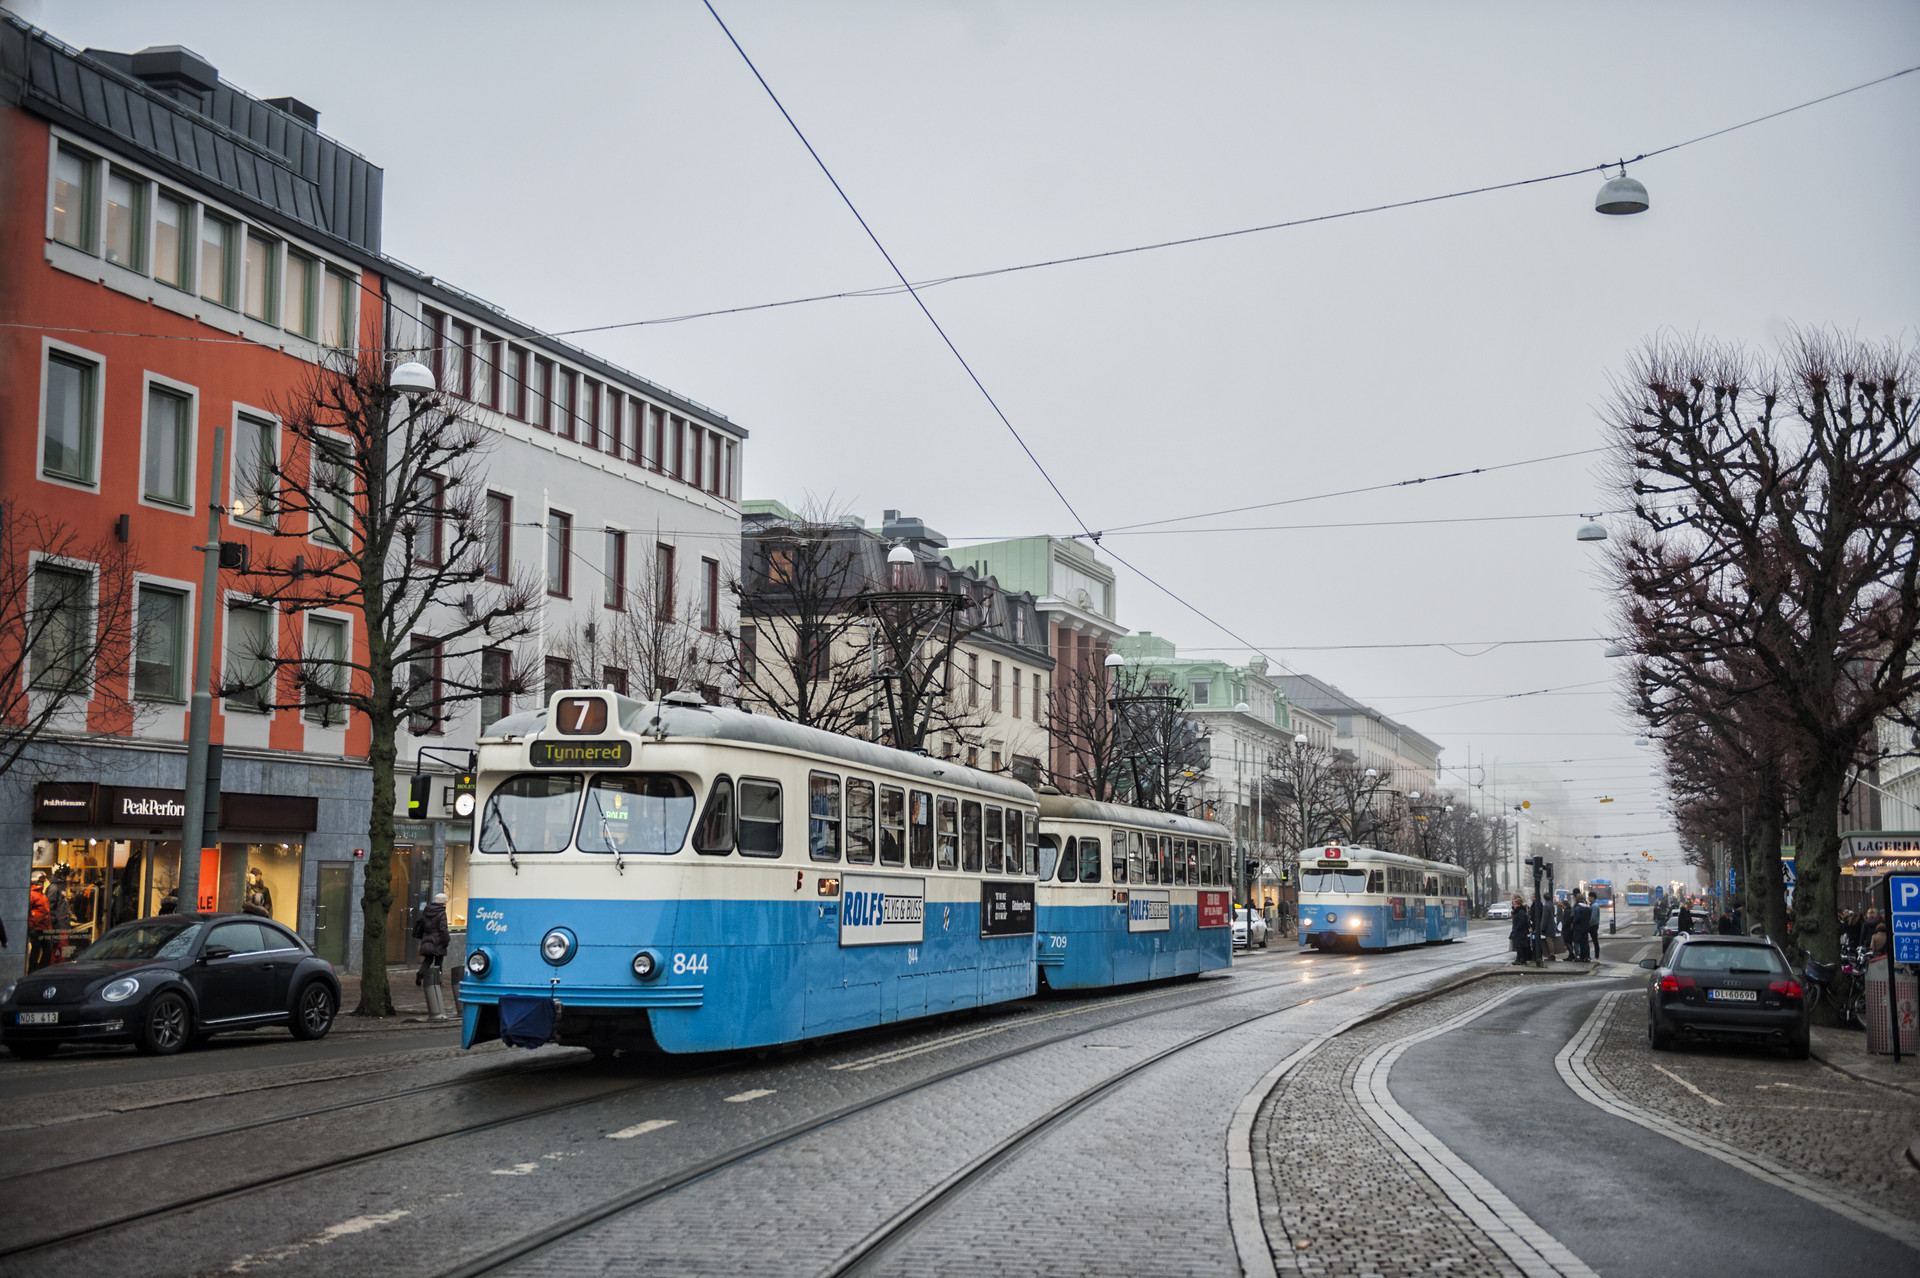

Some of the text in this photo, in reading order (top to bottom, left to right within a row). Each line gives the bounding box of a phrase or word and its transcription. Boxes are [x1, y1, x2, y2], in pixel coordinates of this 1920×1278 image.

[573, 700, 590, 730] 7
[545, 745, 621, 762] Tynnered
[1329, 849, 1336, 857] 5
[198, 896, 213, 909] LE
[1901, 883, 1919, 907] P
[475, 906, 505, 921] Syster
[842, 891, 922, 926] ROLFS FLYG & BUSS
[1129, 899, 1149, 920] ROLFS
[485, 919, 508, 935] Olga
[1050, 936, 1067, 948] 709
[673, 953, 709, 975] 844
[907, 948, 918, 965] 844
[1714, 990, 1755, 999] DL 60690
[40, 1013, 57, 1023] 413
